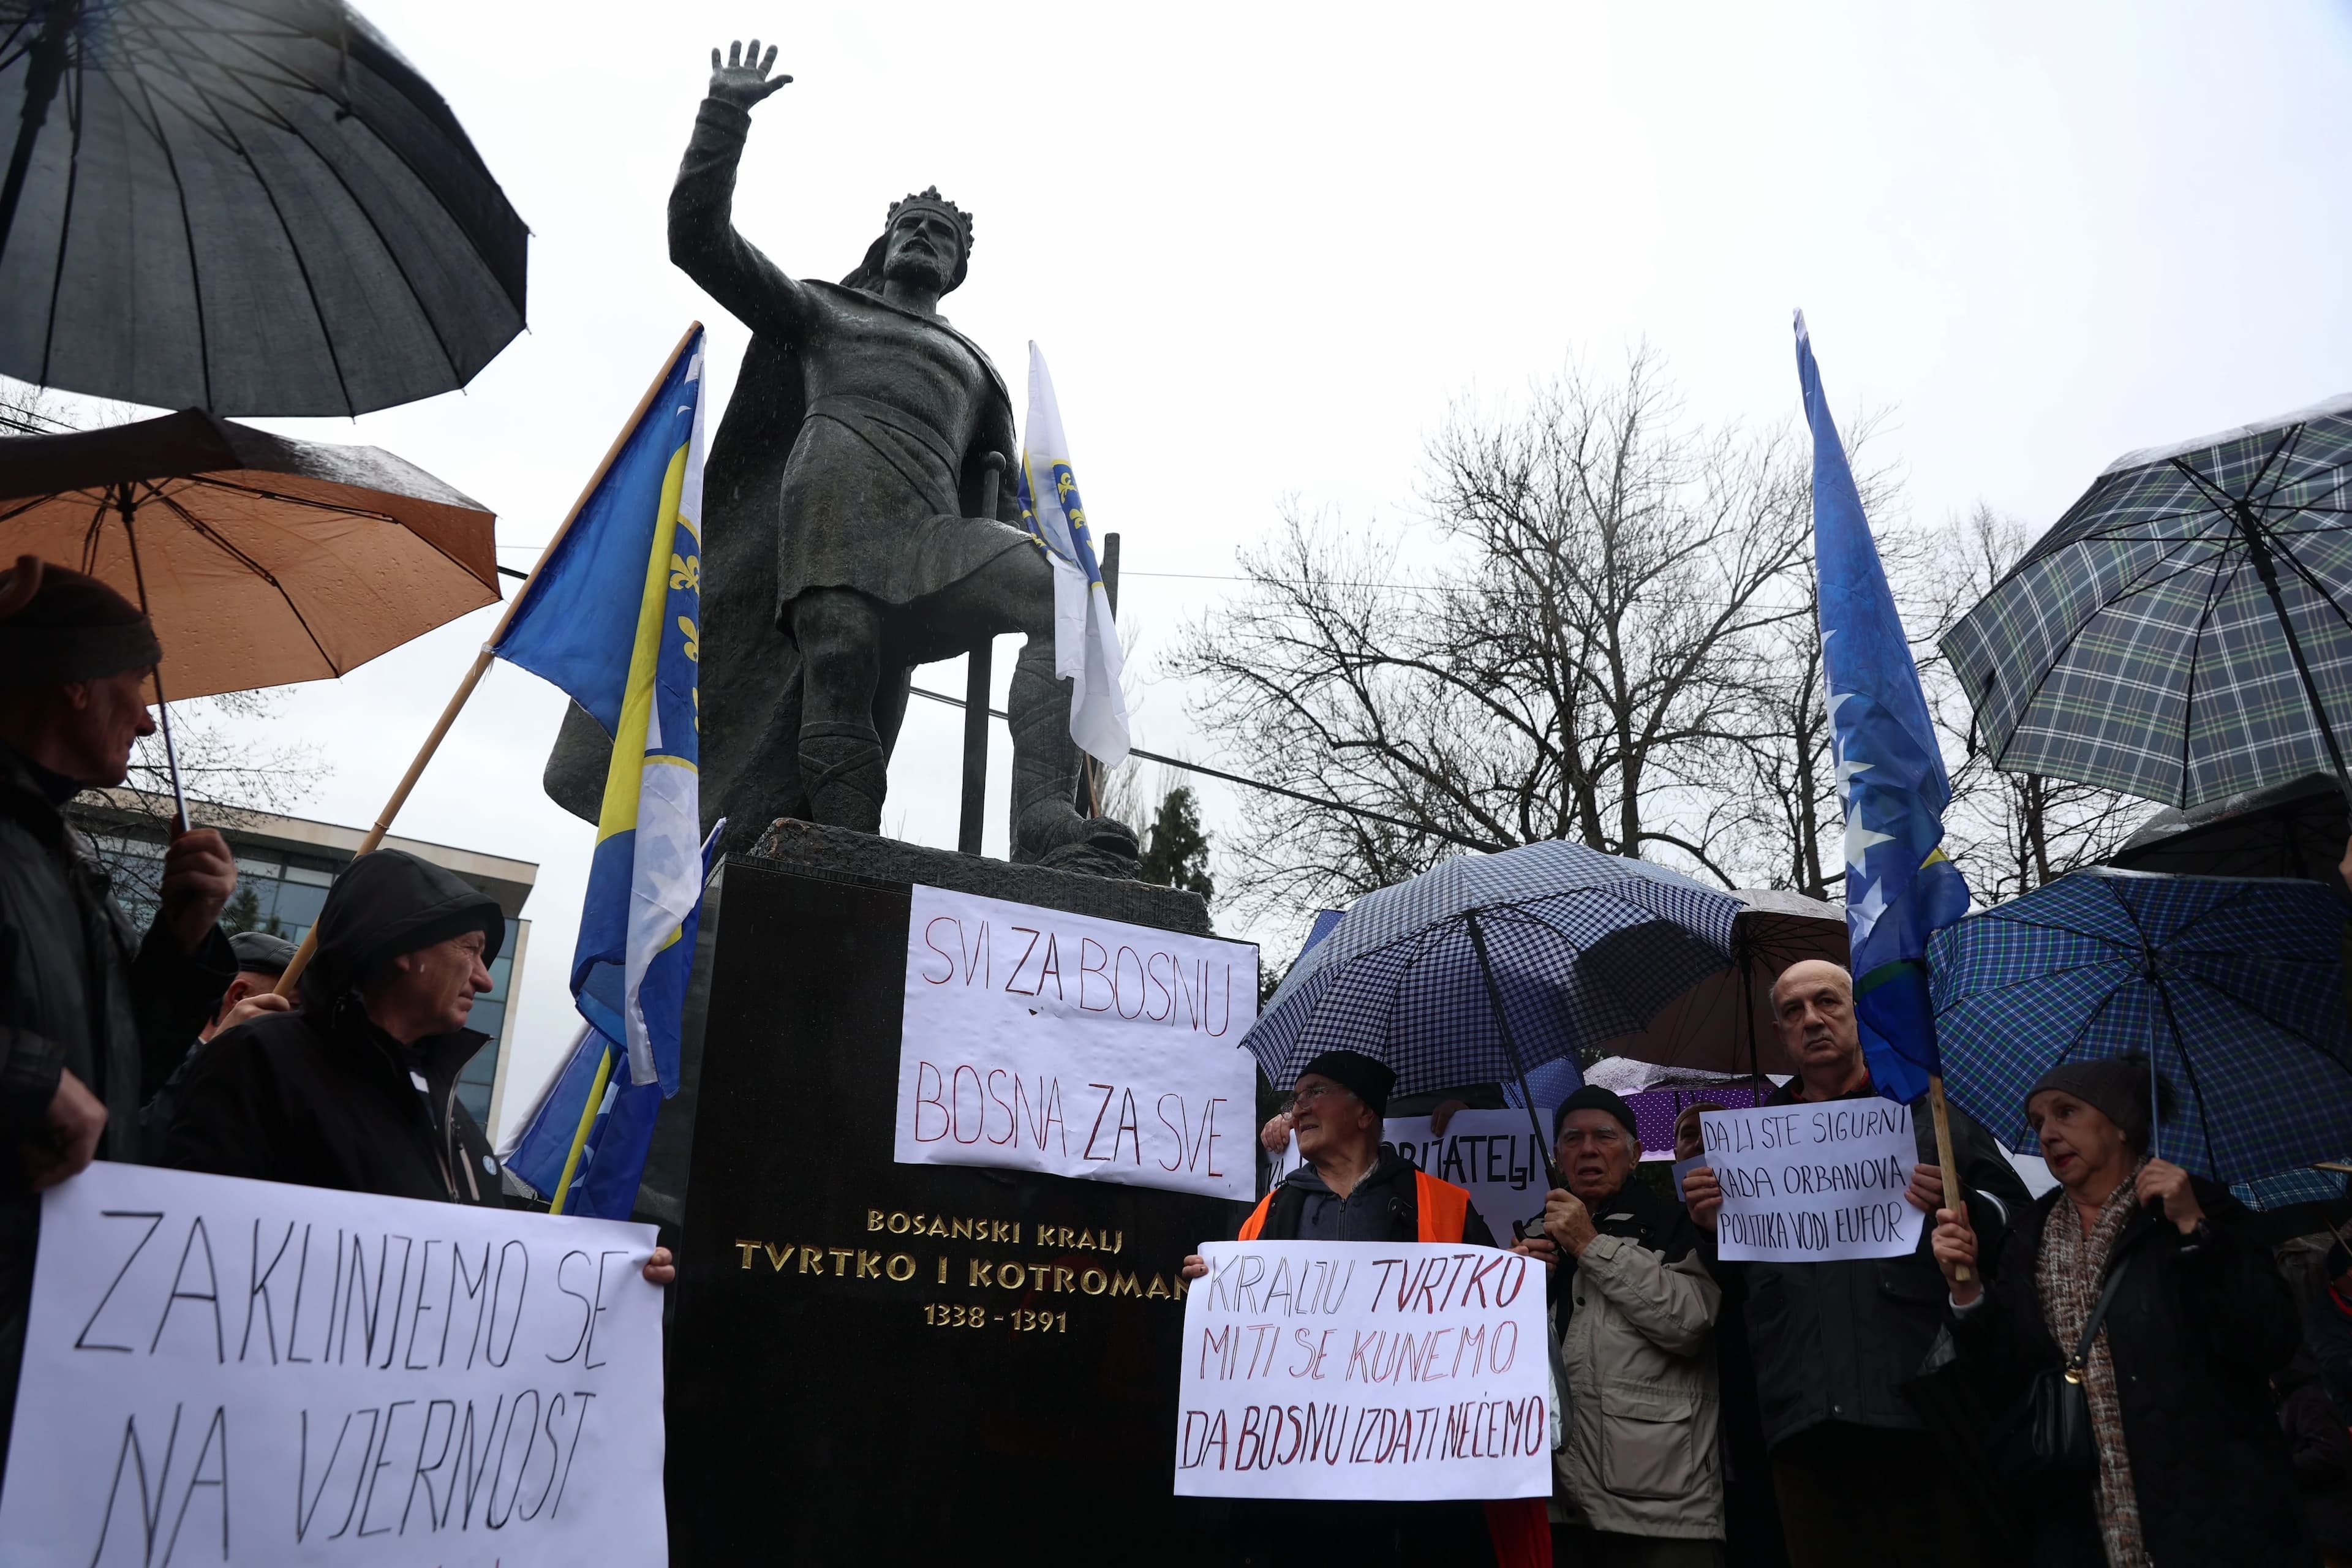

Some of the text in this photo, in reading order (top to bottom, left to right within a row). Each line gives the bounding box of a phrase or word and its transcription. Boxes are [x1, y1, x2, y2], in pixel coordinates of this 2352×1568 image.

[922, 917, 1230, 1037] SVI ZA BOSNU
[914, 1061, 1066, 1158] BOSNA
[1083, 1082, 1140, 1166] ZA
[1157, 1093, 1227, 1177] SVE
[1703, 1106, 1905, 1153] DA LI STE SIGURNI
[1711, 1154, 1907, 1199] KADA ORBANOVA
[867, 1208, 1123, 1254] BOSANSKI KRALJ
[1720, 1201, 1905, 1251] POLITIKA VODI EUFOR
[74, 1210, 629, 1370] ZAKLINJEMO SE
[736, 1238, 916, 1282] TVRTKO
[937, 1255, 948, 1284] I
[1207, 1254, 1526, 1318] KRALJU TVRTKO
[923, 1302, 986, 1328] 1338
[1010, 1307, 1067, 1333] 1391
[1289, 1327, 1338, 1380] SE
[1345, 1321, 1518, 1386] KUNEMO
[1178, 1408, 1229, 1471] DA
[1235, 1401, 1349, 1471] BOSNU
[1349, 1407, 1440, 1464] IZDATI
[91, 1389, 597, 1568] NA VJERNOST
